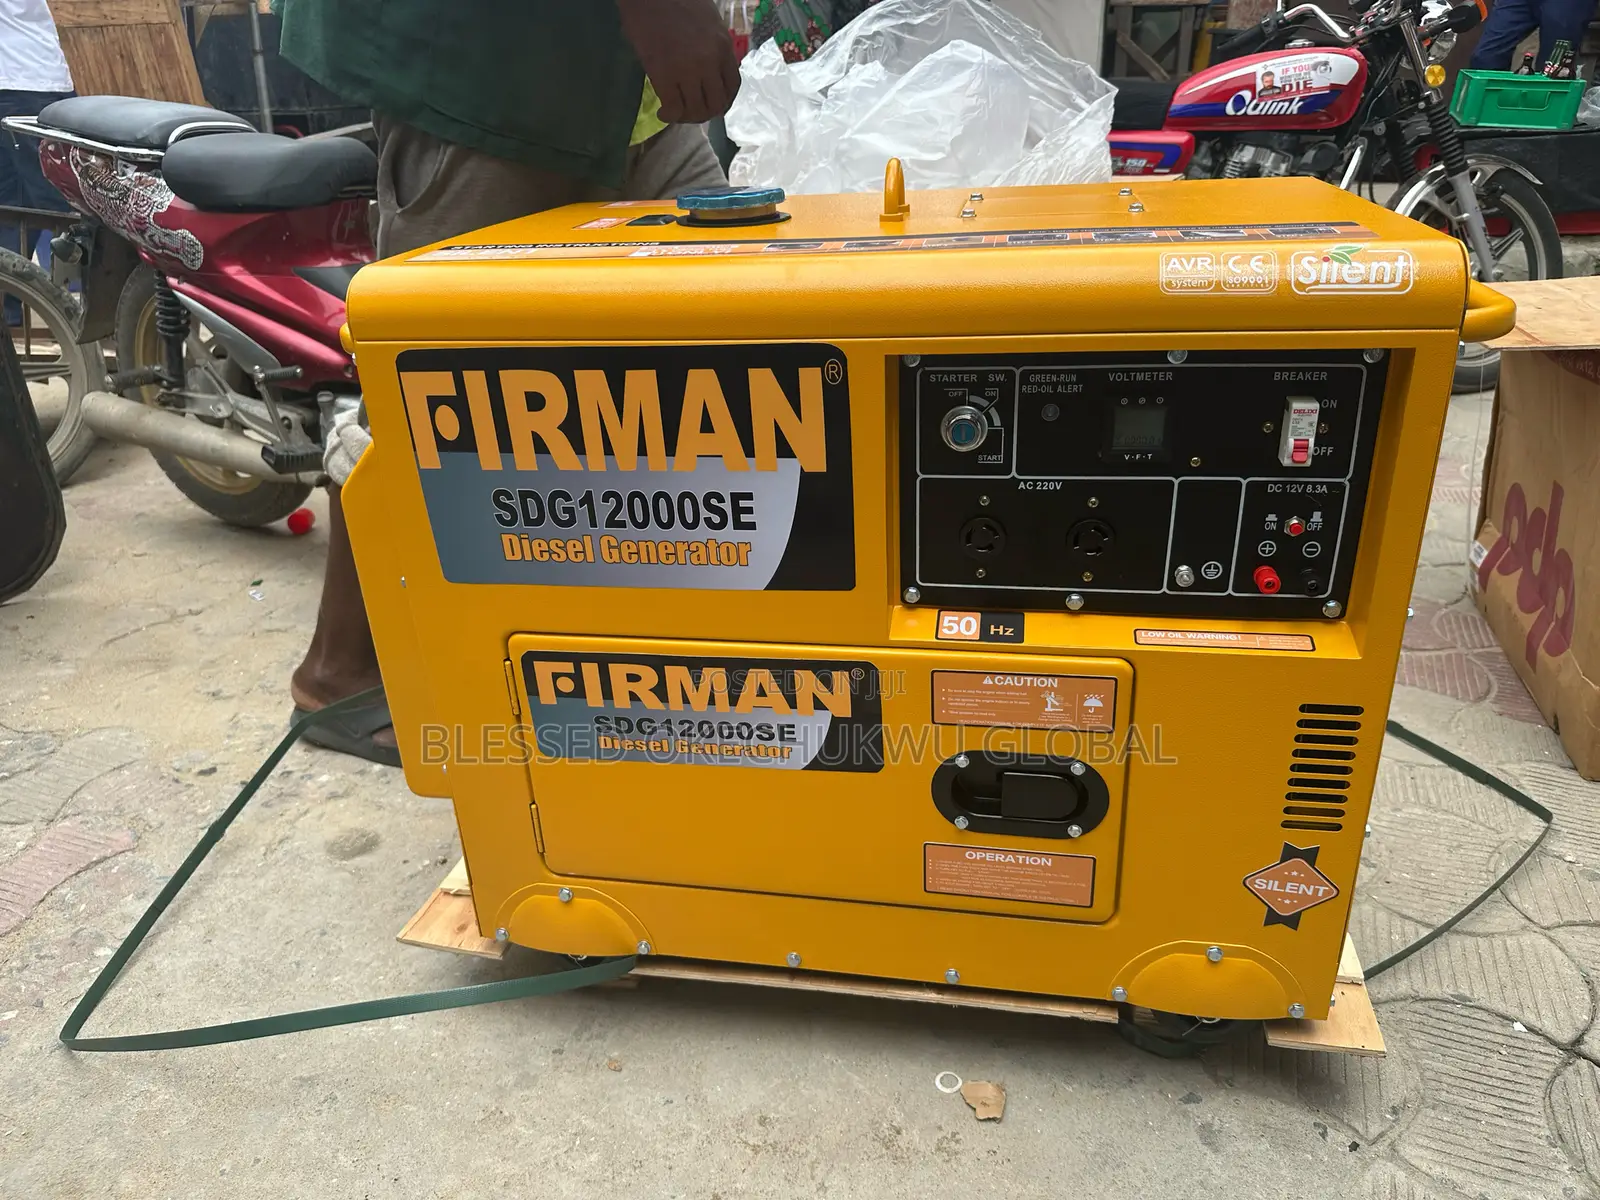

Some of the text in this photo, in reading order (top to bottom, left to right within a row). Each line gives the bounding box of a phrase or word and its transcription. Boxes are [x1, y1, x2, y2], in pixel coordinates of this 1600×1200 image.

[1293, 65, 1309, 73] YOU
[1282, 79, 1312, 92] DIE
[1166, 255, 1212, 271] AVR
[1228, 255, 1264, 273] CE
[1298, 254, 1407, 284] Silent
[1171, 277, 1208, 289] system
[929, 373, 1008, 383] STARTER SW.
[1029, 373, 1077, 383] GREEN-RUN
[1108, 371, 1174, 382] VOLTMETER
[1273, 371, 1328, 382] BREAKER
[1021, 384, 1084, 394] RED-OIL ALERT
[1321, 399, 1338, 409] ON
[400, 366, 827, 473] FIRMAN
[1313, 446, 1334, 456] OFF
[1018, 481, 1063, 490] AC 220V
[1267, 483, 1328, 494] DC 12V 8.3A
[490, 486, 758, 532] SDG12000SE
[1264, 521, 1277, 531] ON
[1306, 522, 1323, 532] OFF
[500, 532, 752, 567] Diesel Generator
[942, 615, 1014, 636] 50 Hz
[1141, 631, 1166, 639] LOW
[1186, 632, 1242, 641] WARNING!
[994, 675, 1058, 688] CAUTION
[533, 660, 852, 718] FIRMAN
[593, 714, 797, 743] SDG12000SE
[597, 735, 793, 760] Diesel Generator
[965, 850, 1052, 867] OPERATION
[1253, 878, 1329, 897] SILENT
